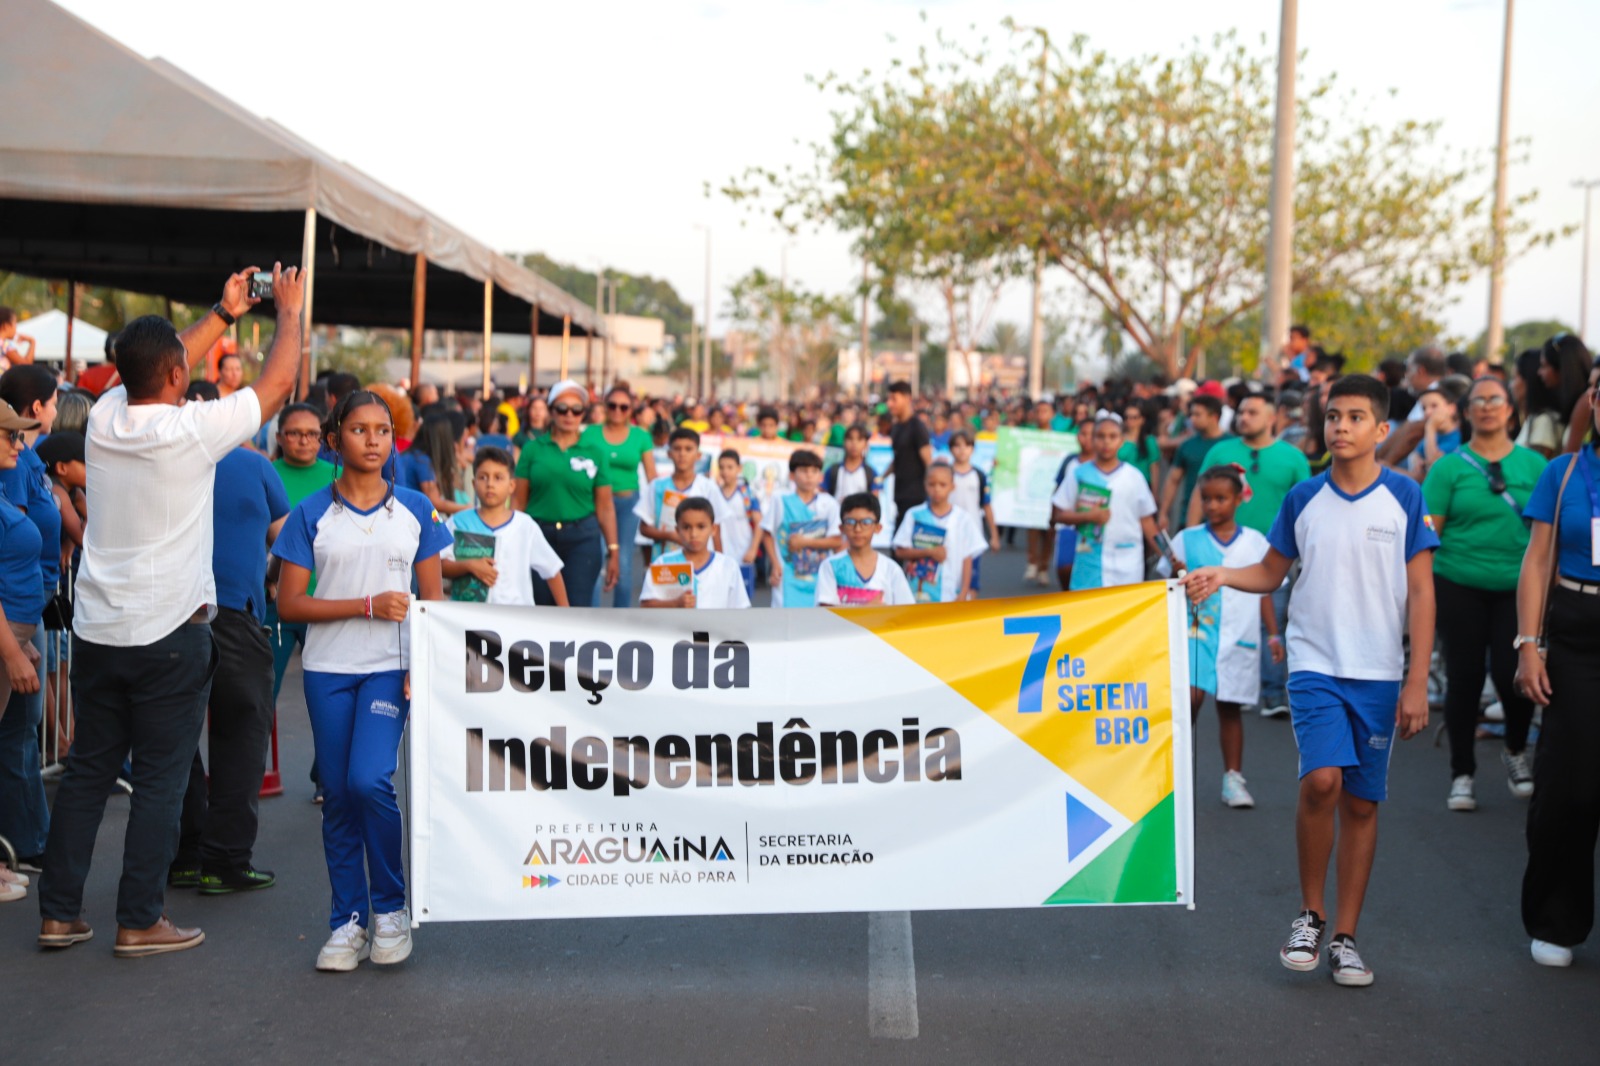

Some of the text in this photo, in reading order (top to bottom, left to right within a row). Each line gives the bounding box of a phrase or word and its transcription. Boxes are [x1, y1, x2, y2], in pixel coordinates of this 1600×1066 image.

[465, 630, 750, 706] Berço da
[1003, 614, 1085, 713] 7 de
[1057, 682, 1148, 712] SETEM
[1095, 716, 1149, 745] BRO
[465, 716, 963, 797] Independência
[535, 822, 658, 834] PREFEITURA
[758, 833, 853, 847] SECRETARIA
[759, 849, 874, 867] DA EDUCAÇÃO
[566, 869, 736, 887] CIDADE QUE NÃO PARA
